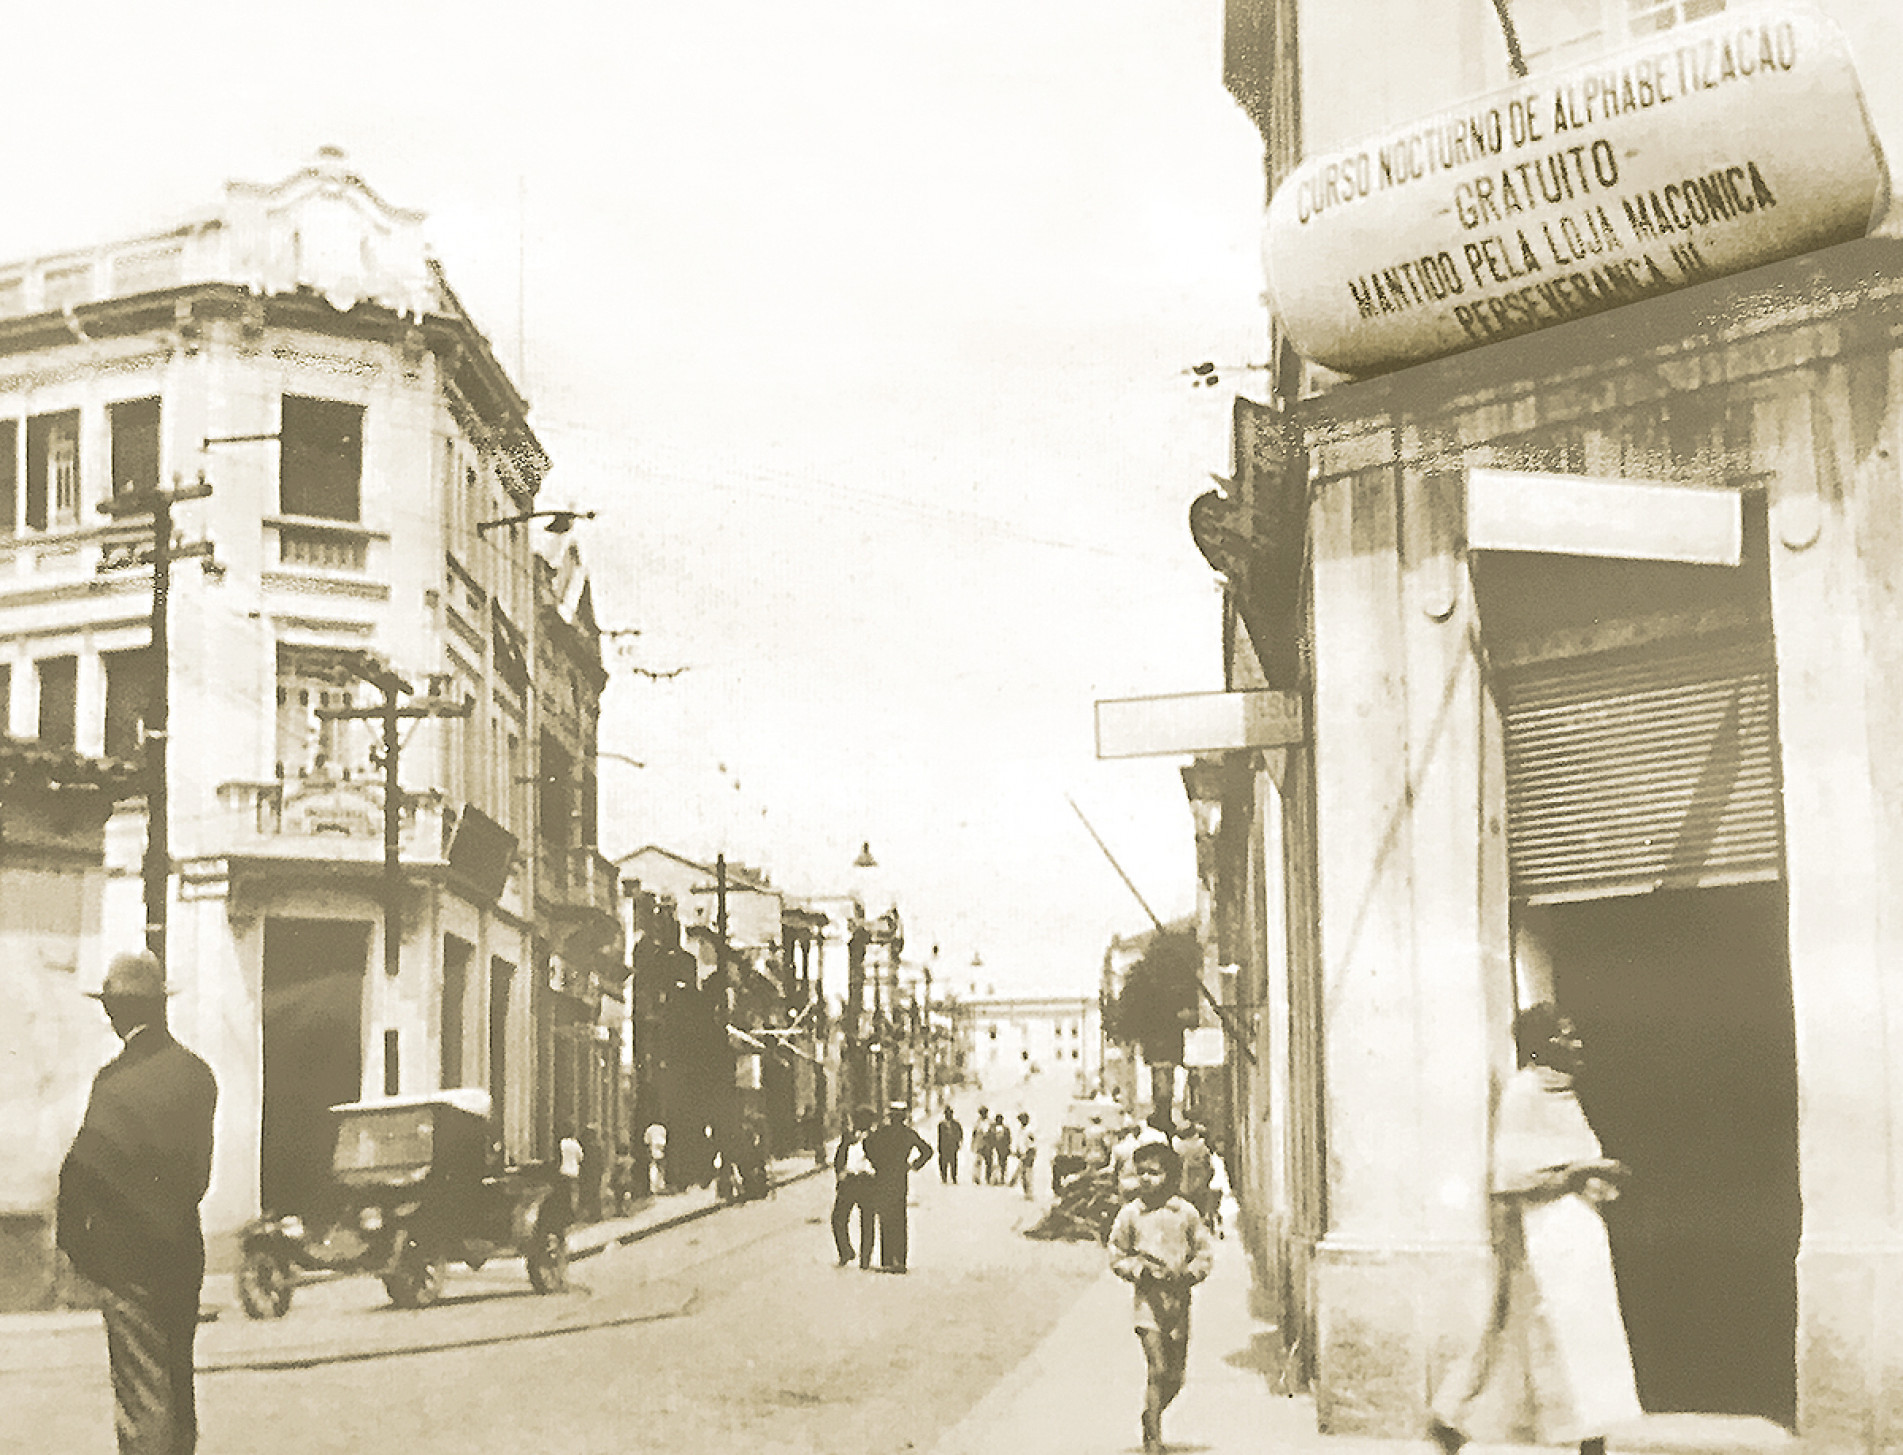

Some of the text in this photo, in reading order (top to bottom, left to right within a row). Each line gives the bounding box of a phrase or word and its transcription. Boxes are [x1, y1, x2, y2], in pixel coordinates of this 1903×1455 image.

[1296, 152, 1370, 225] CURSO
[1379, 107, 1503, 191] NOCTURNO
[1510, 94, 1543, 148] DE
[1348, 250, 1465, 320] MANTIDO
[1463, 229, 1542, 289] PELA
[1541, 205, 1625, 264] LOJA
